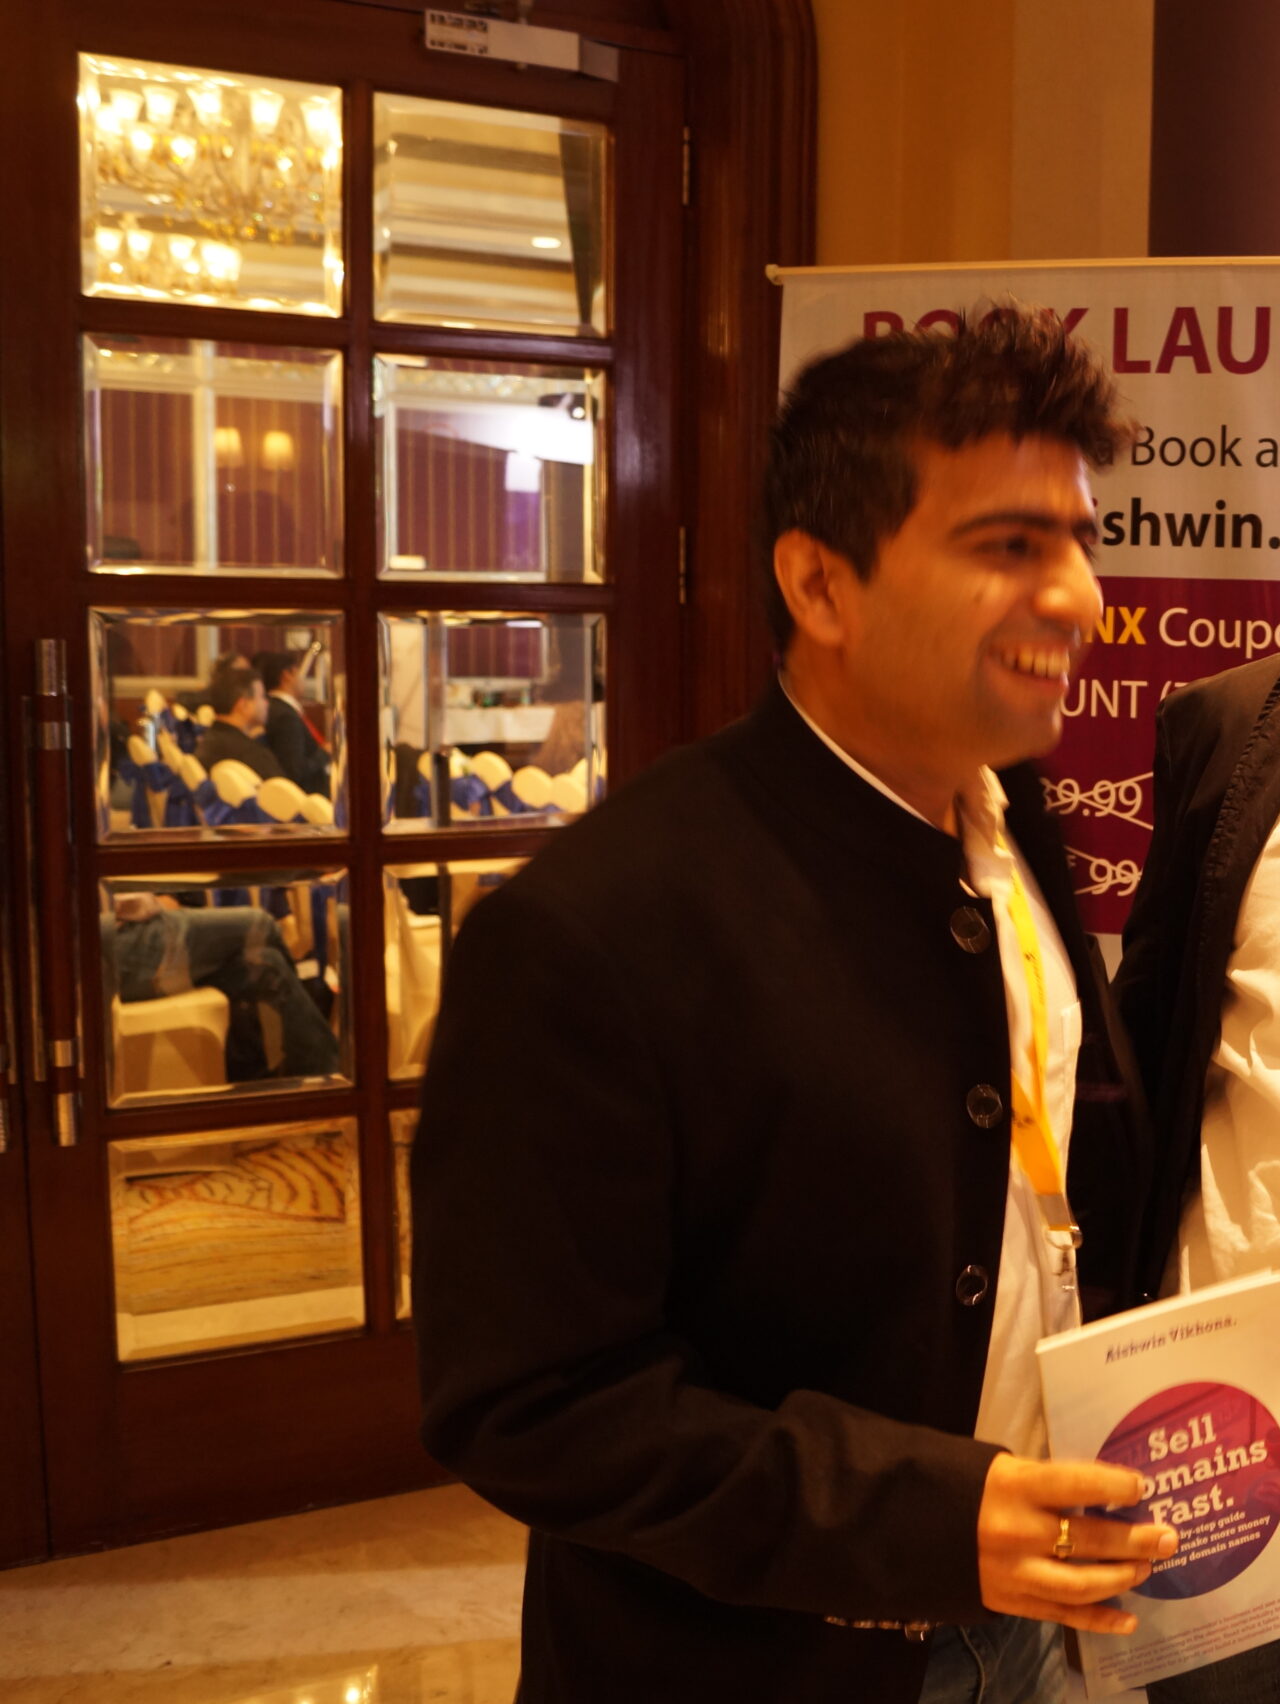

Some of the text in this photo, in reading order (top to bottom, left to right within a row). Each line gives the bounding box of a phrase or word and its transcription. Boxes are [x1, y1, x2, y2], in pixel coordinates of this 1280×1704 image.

[1131, 425, 1243, 468] Book
[1148, 1412, 1217, 1462] Sell
[1108, 1440, 1269, 1510] omains
[1148, 1482, 1235, 1526] Fast.
[1217, 1511, 1246, 1529] guide
[1152, 1530, 1262, 1574] selling domain names
[1180, 1515, 1271, 1554] make more money
